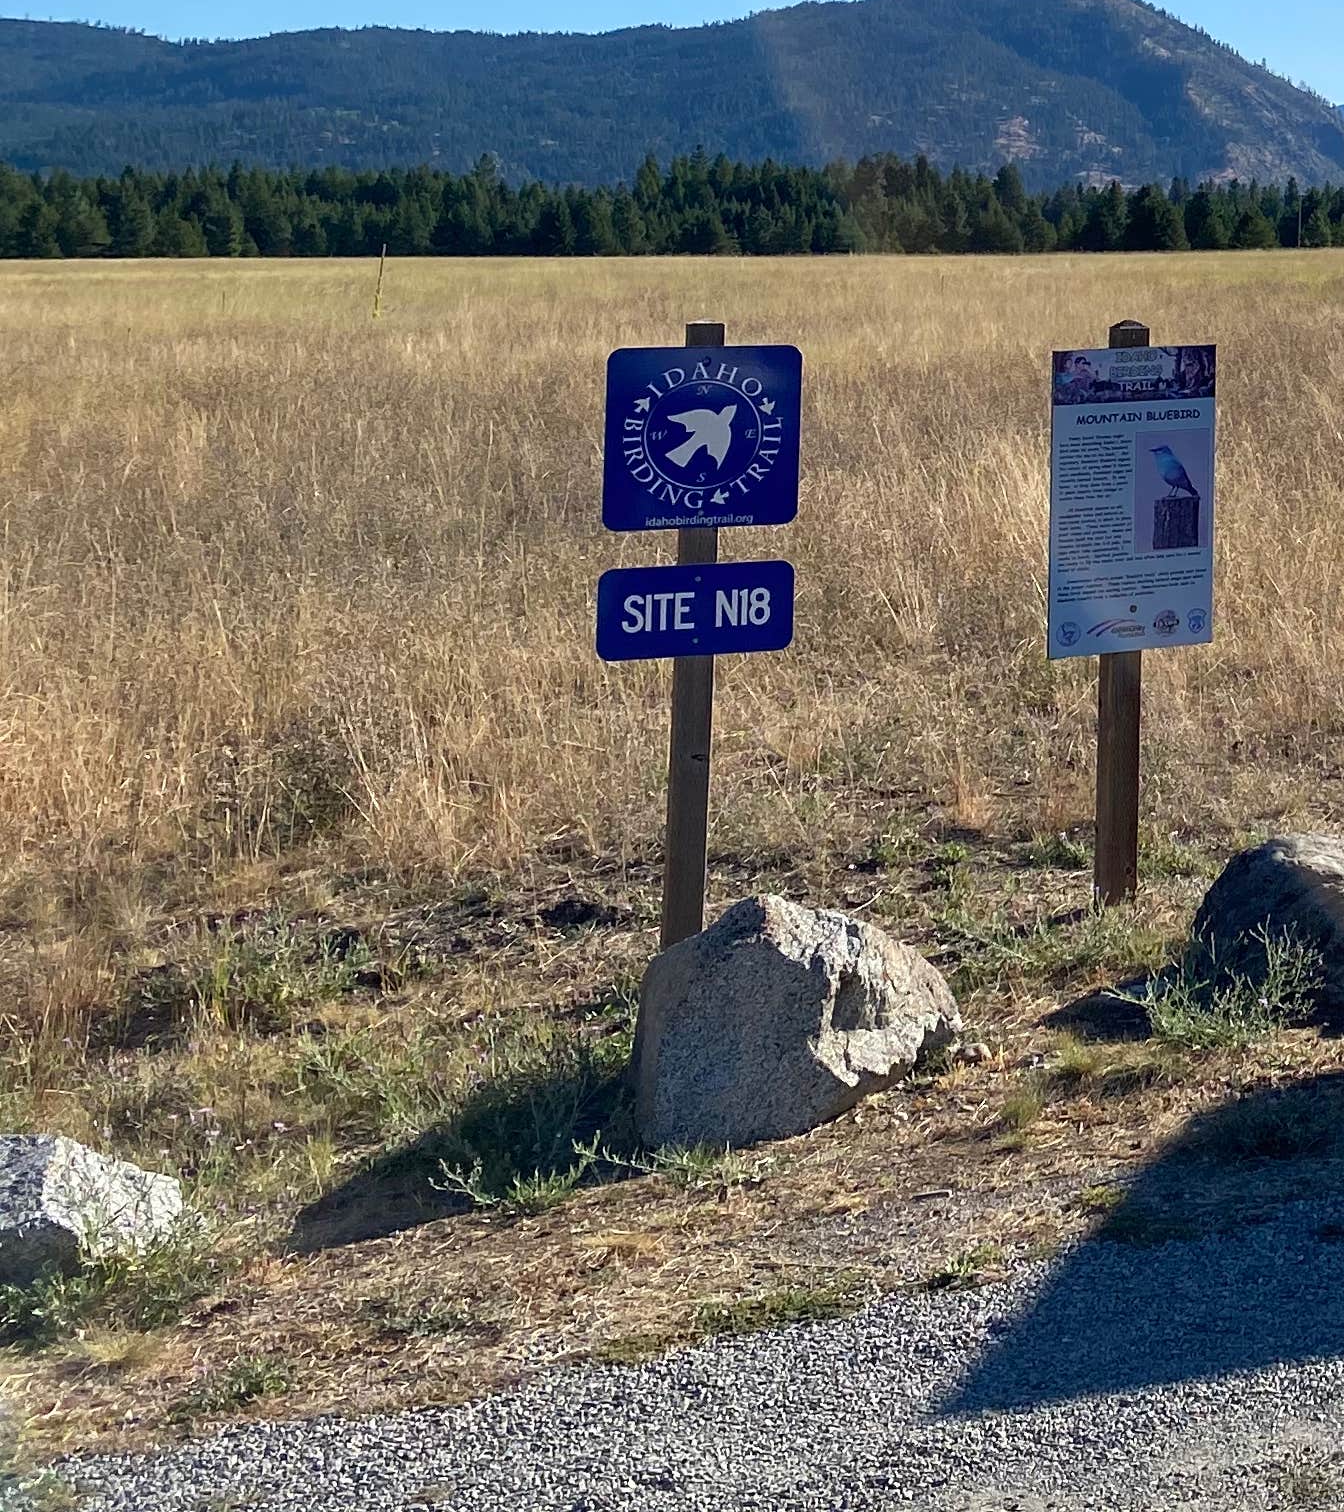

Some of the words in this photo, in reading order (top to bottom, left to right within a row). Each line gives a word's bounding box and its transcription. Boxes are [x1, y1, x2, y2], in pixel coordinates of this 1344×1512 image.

[646, 361, 763, 399] IDAHO
[1119, 381, 1155, 392] TRAIL
[696, 384, 712, 396] N
[1076, 412, 1142, 426] MOUNTAIN
[1146, 408, 1201, 421] BLUEBIRD
[649, 428, 668, 441] W
[744, 428, 757, 439] E
[622, 417, 704, 509] BIRDING
[729, 416, 784, 496] TRAIL
[696, 472, 707, 483] S
[645, 514, 754, 527] idahobirdingtrail.org
[621, 591, 696, 634] SITE
[715, 587, 771, 628] N18
